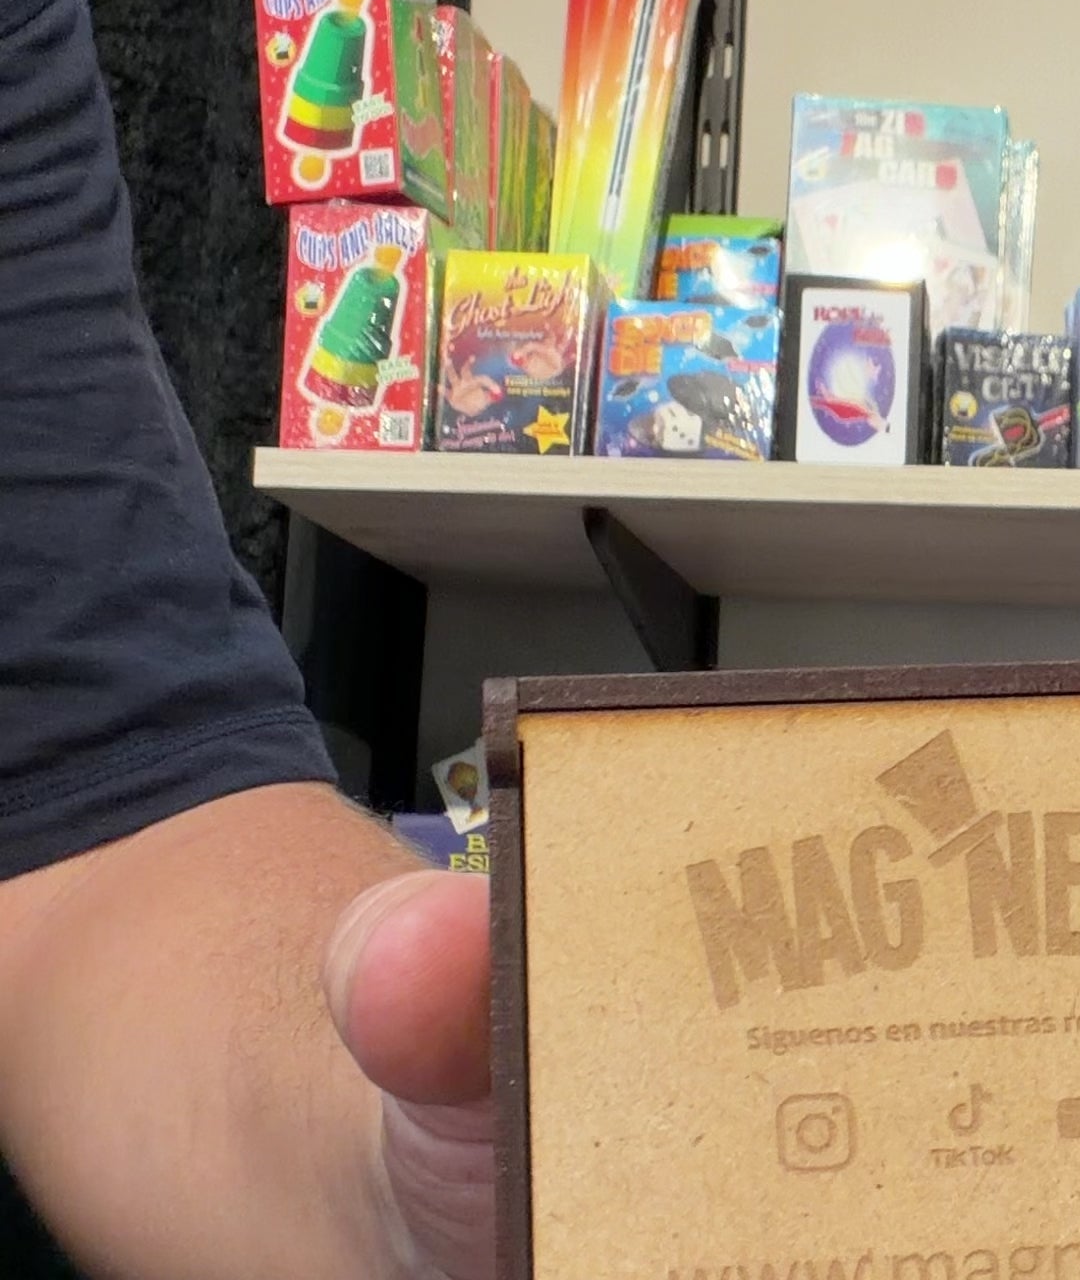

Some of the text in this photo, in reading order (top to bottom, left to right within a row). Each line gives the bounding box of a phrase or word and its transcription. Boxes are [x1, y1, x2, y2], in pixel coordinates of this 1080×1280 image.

[298, 226, 336, 271] CUPS
[340, 218, 369, 265] AND
[886, 1023, 922, 1042] en
[929, 1014, 1057, 1040] nuestras
